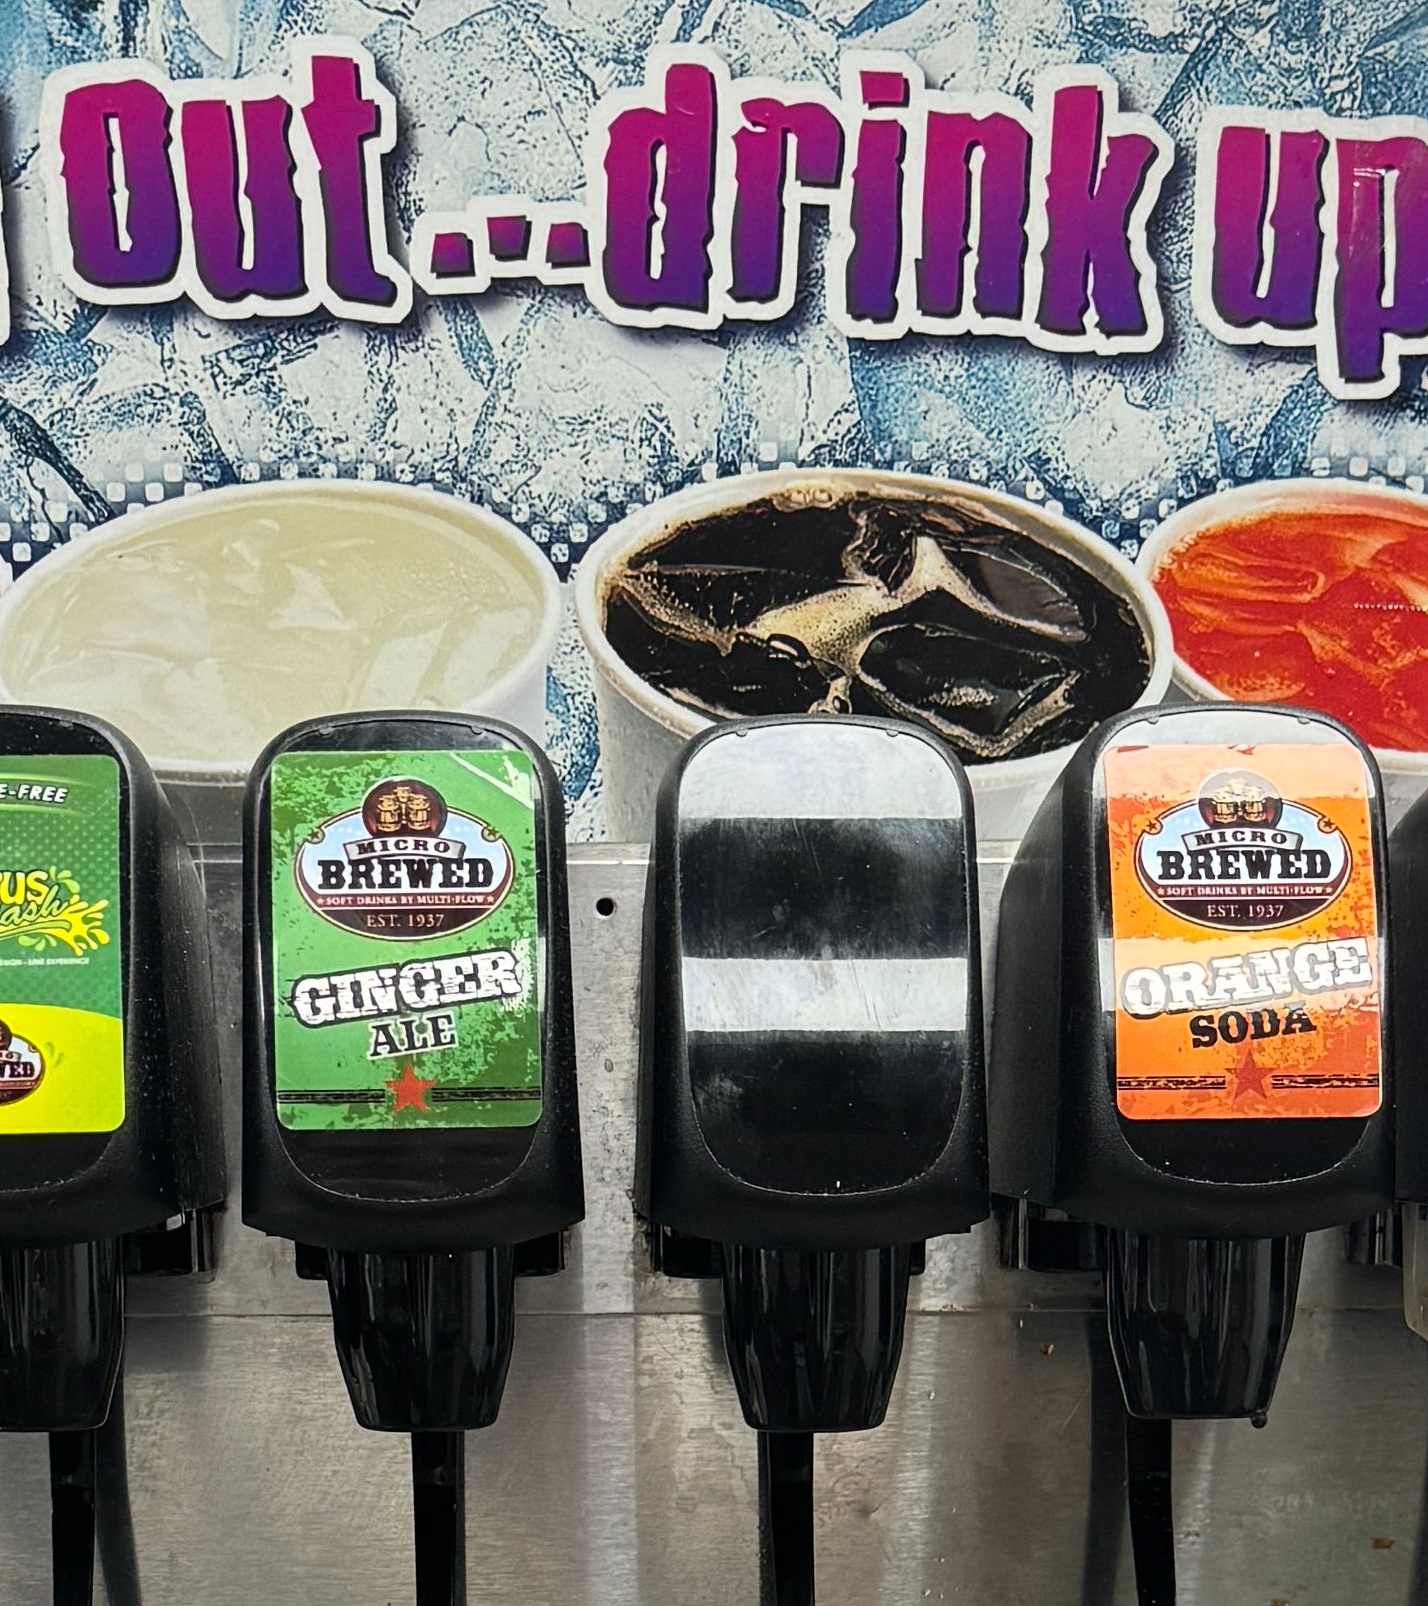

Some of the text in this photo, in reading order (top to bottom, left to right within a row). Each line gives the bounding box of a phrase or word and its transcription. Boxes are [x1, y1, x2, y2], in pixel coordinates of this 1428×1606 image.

[355, 838, 451, 855] MICRO
[1194, 829, 1288, 846] MICRO
[317, 857, 495, 890] BREWED
[1156, 849, 1332, 881] BREWED
[326, 896, 353, 905] SOFT
[357, 896, 398, 905] DRINKS
[401, 896, 414, 904] BY
[1207, 904, 1284, 918] EST. 1937
[366, 914, 445, 927] EST. 1937
[292, 949, 523, 1026] GINGER
[1123, 937, 1372, 1018] ORANGE
[370, 1013, 457, 1057] ALE
[1188, 1003, 1318, 1049] SODA
